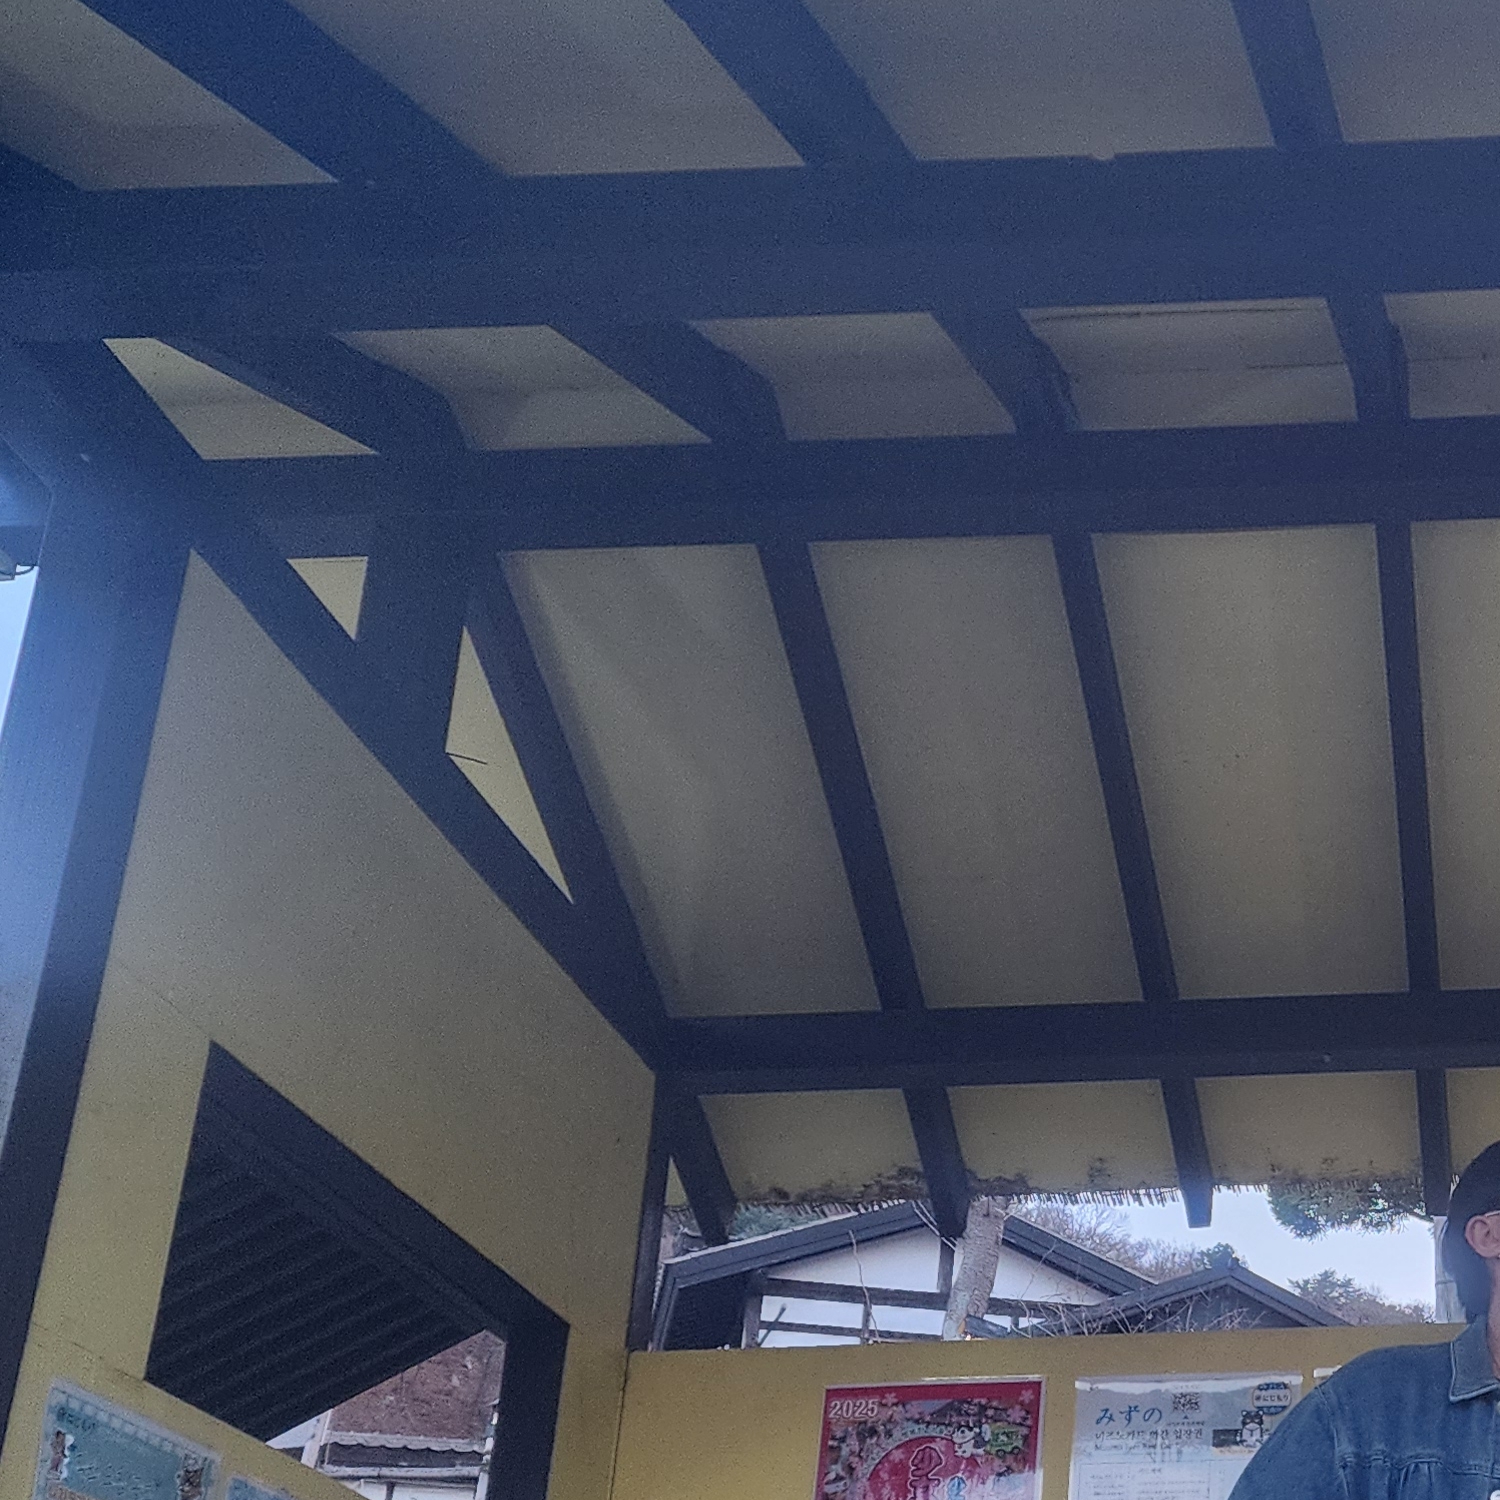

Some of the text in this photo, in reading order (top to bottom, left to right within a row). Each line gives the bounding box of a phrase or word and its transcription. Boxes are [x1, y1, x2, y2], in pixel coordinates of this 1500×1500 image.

[829, 1400, 879, 1420] 2025
[1095, 1405, 1163, 1428] みずの
